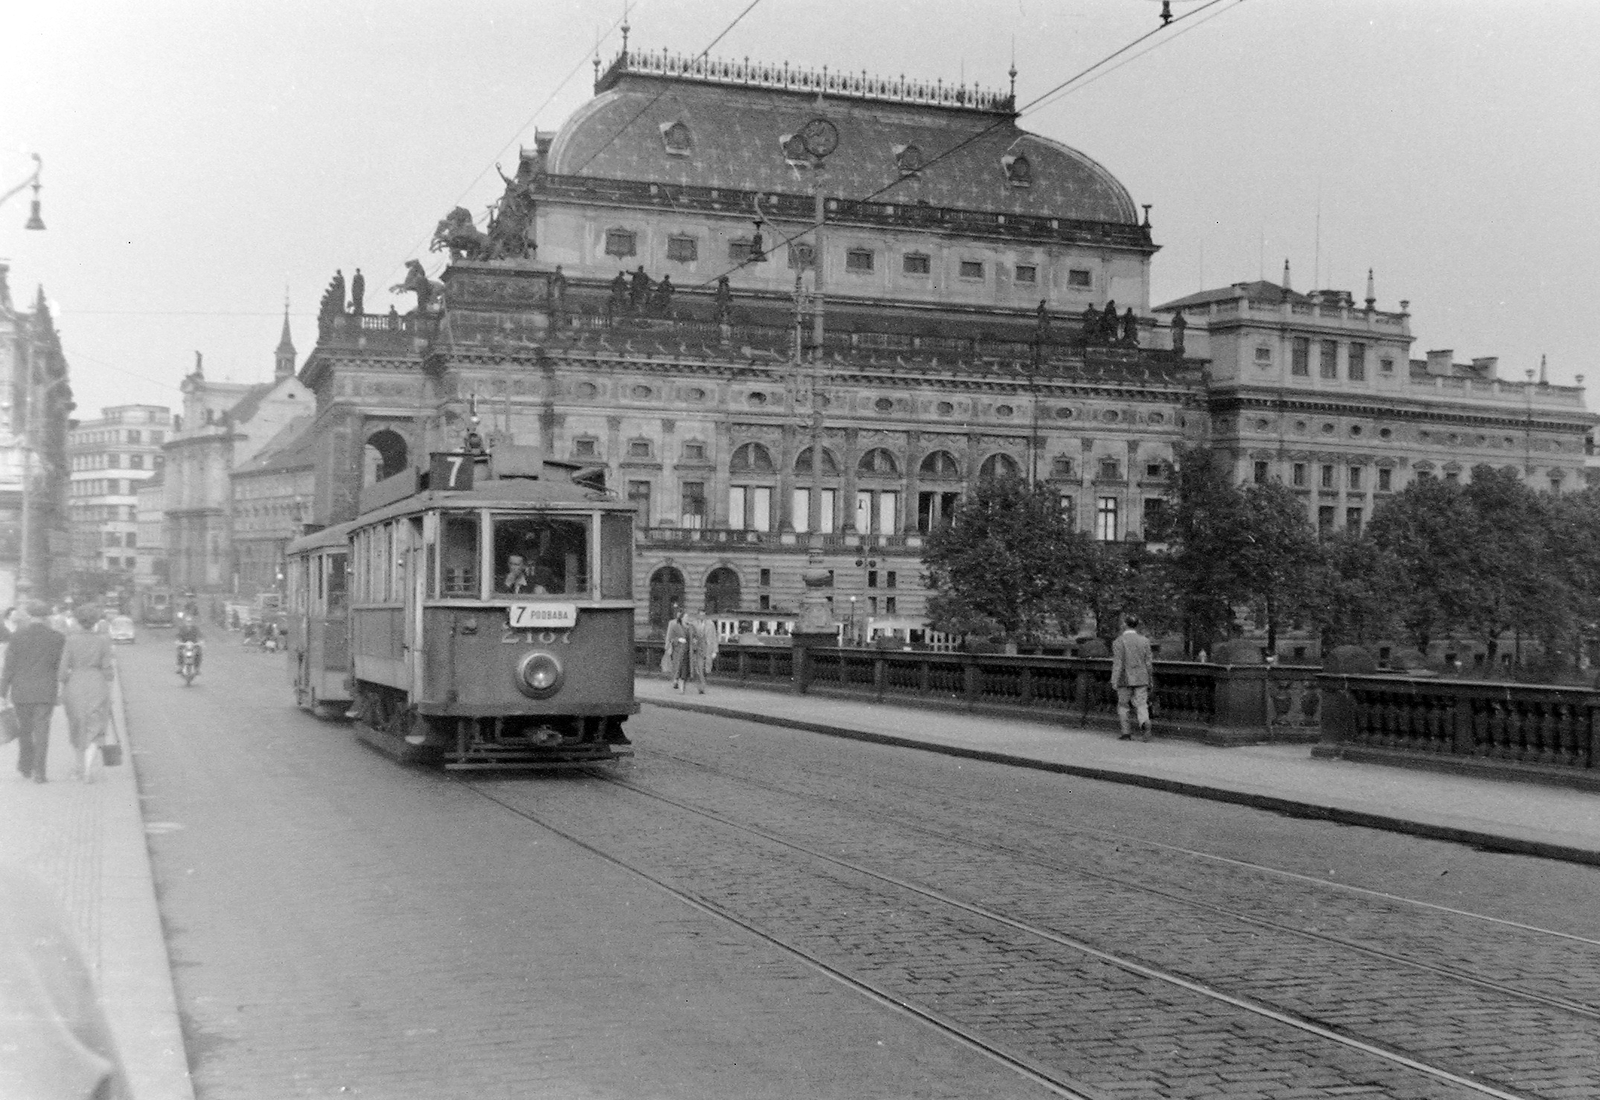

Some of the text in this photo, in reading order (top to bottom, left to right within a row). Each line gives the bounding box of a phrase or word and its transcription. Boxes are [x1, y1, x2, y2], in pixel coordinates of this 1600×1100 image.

[446, 456, 464, 487] 7
[516, 606, 569, 624] 7 PODBABA
